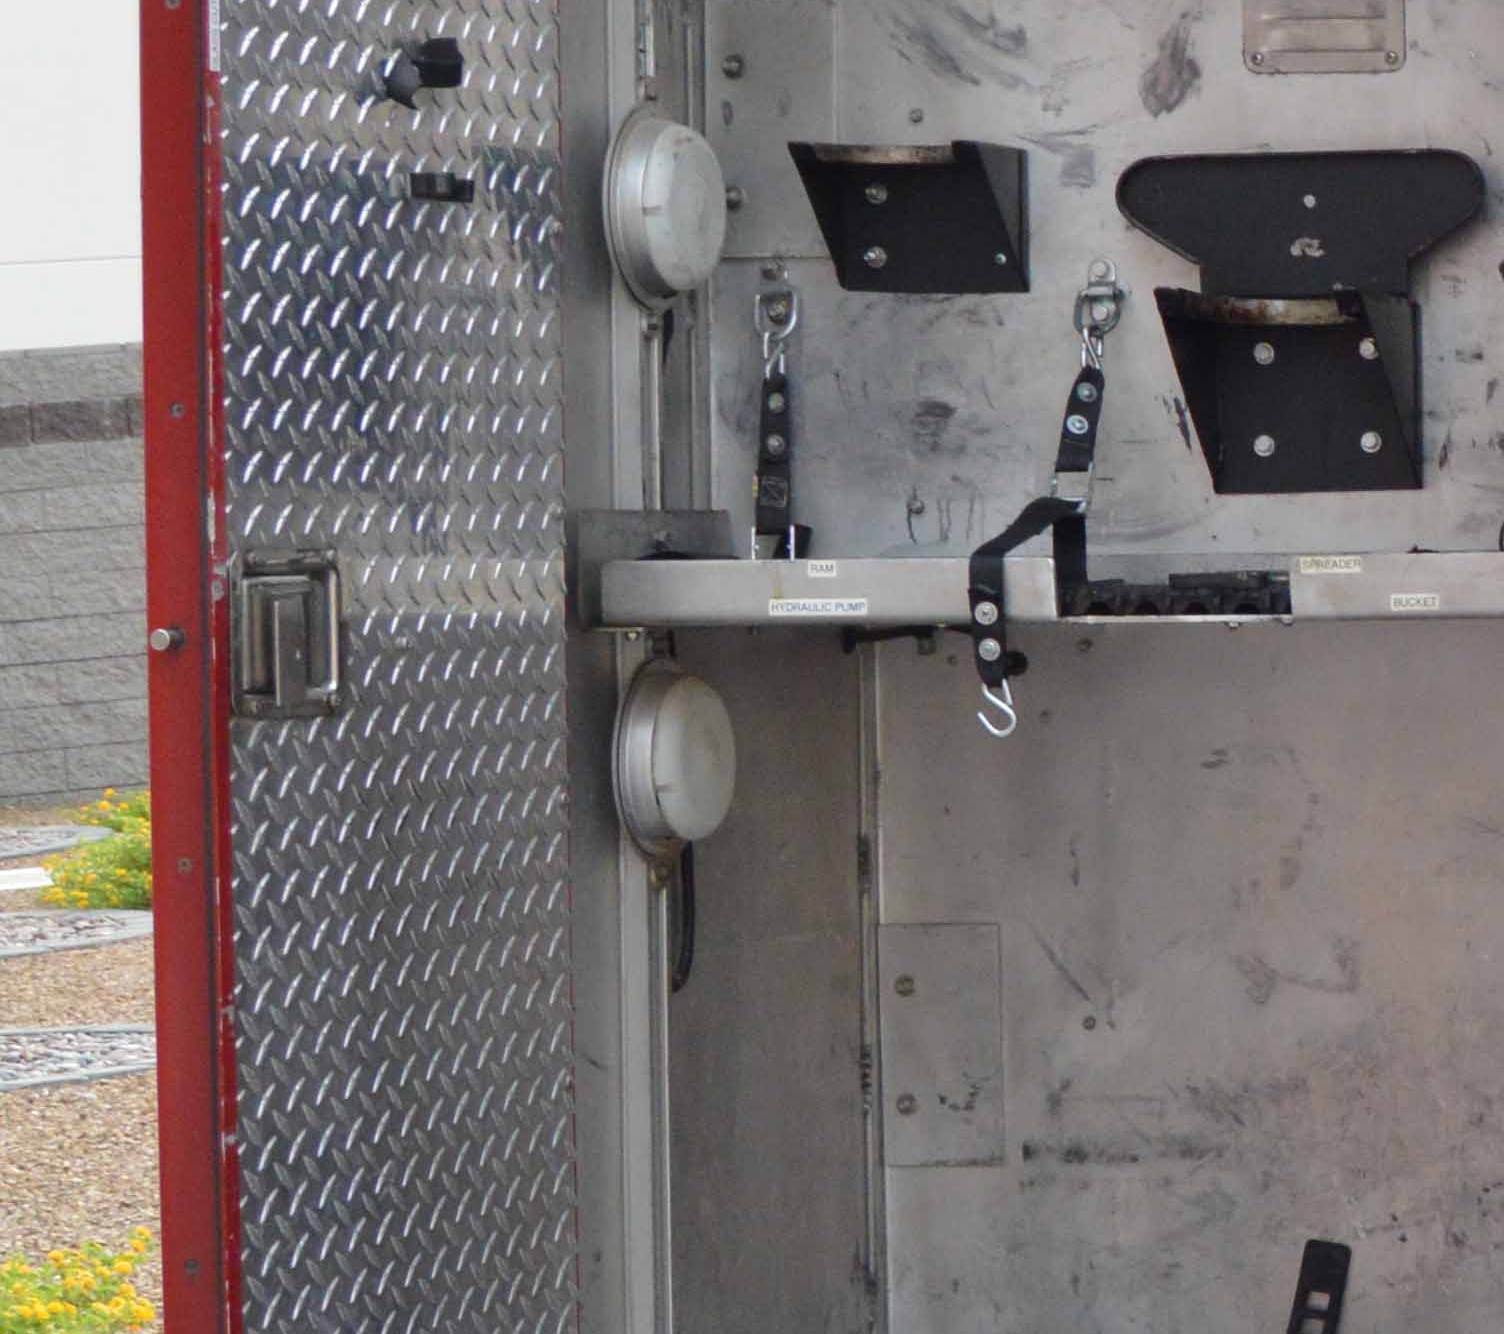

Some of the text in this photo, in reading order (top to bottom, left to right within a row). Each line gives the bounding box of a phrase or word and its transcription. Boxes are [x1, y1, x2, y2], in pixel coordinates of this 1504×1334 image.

[810, 563, 834, 572] RAM
[771, 601, 866, 612] HYDRAULIC PUMP
[1393, 596, 1437, 609] BUCKET
